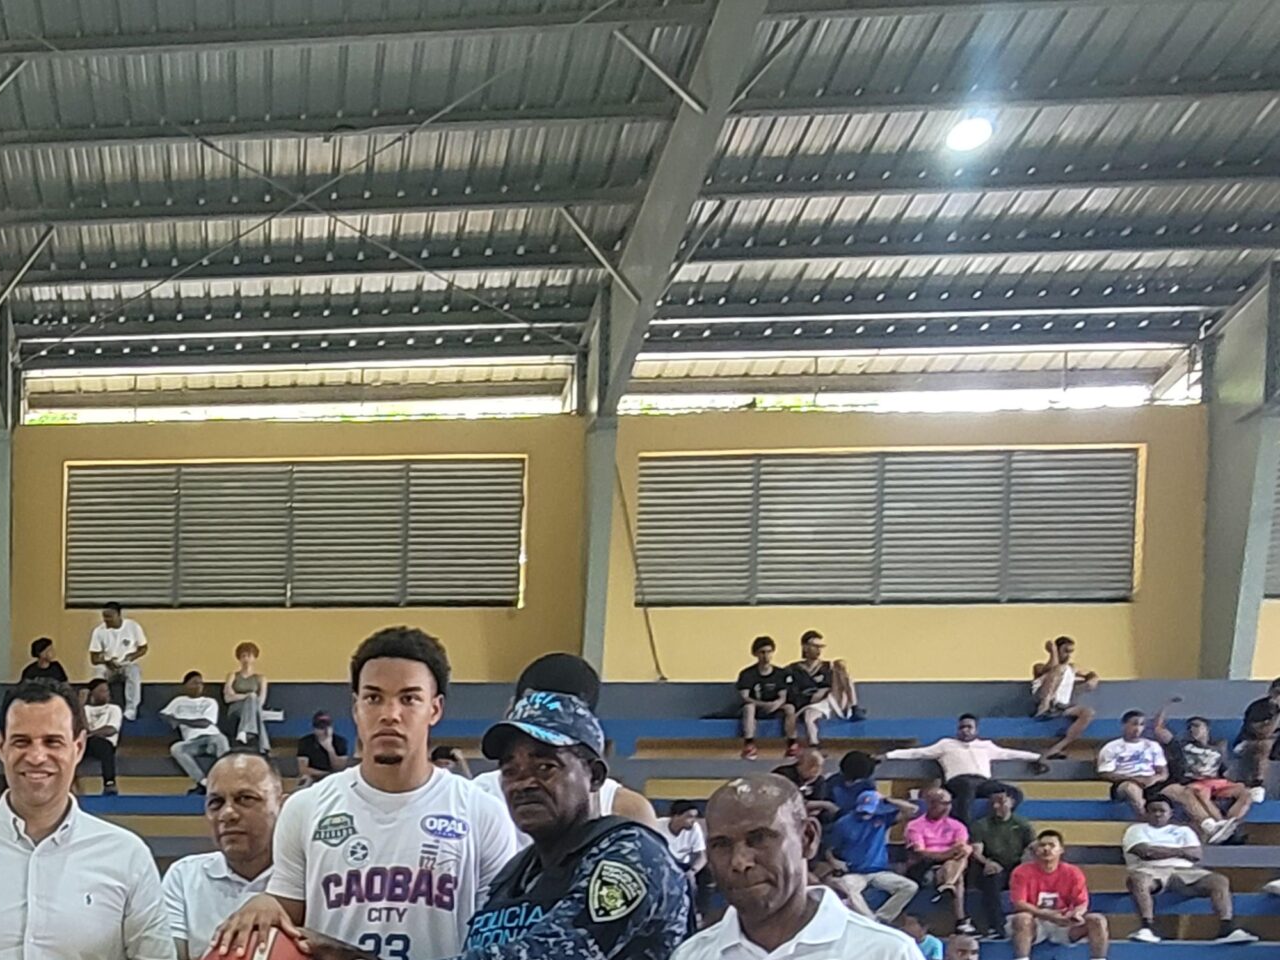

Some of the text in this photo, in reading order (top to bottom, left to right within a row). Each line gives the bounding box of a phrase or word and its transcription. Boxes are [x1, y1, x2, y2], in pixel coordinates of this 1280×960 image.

[425, 816, 467, 835] OPAL
[322, 866, 457, 912] CAOBAS
[367, 907, 409, 923] CITY
